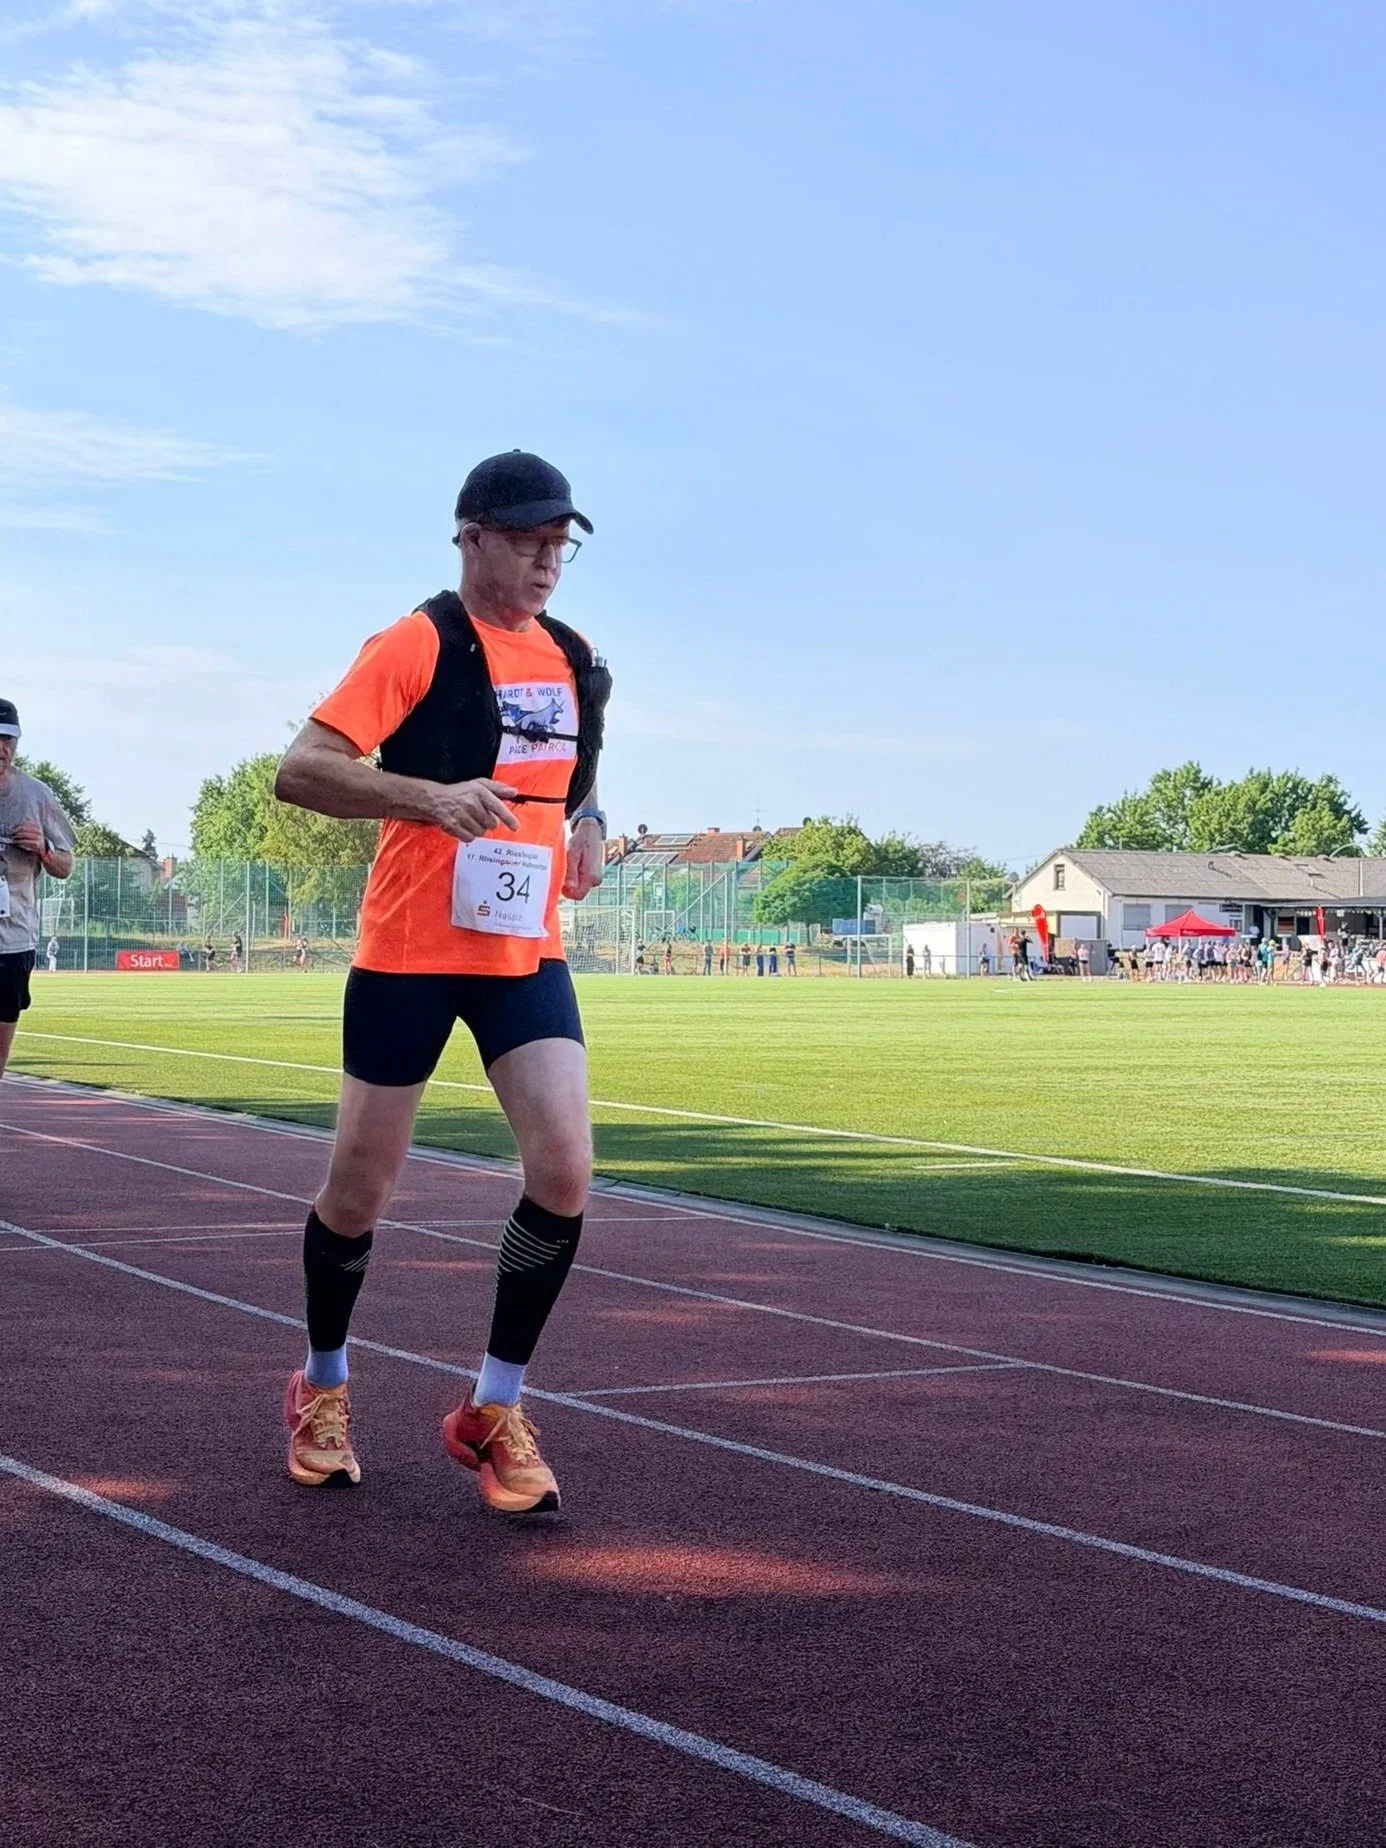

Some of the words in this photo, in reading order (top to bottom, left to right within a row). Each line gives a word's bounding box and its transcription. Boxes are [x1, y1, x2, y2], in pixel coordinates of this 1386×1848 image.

[525, 687, 533, 698] &
[537, 687, 563, 697] WOLF
[531, 741, 566, 753] PATROL
[495, 871, 530, 904] 34
[130, 954, 164, 968] Start
